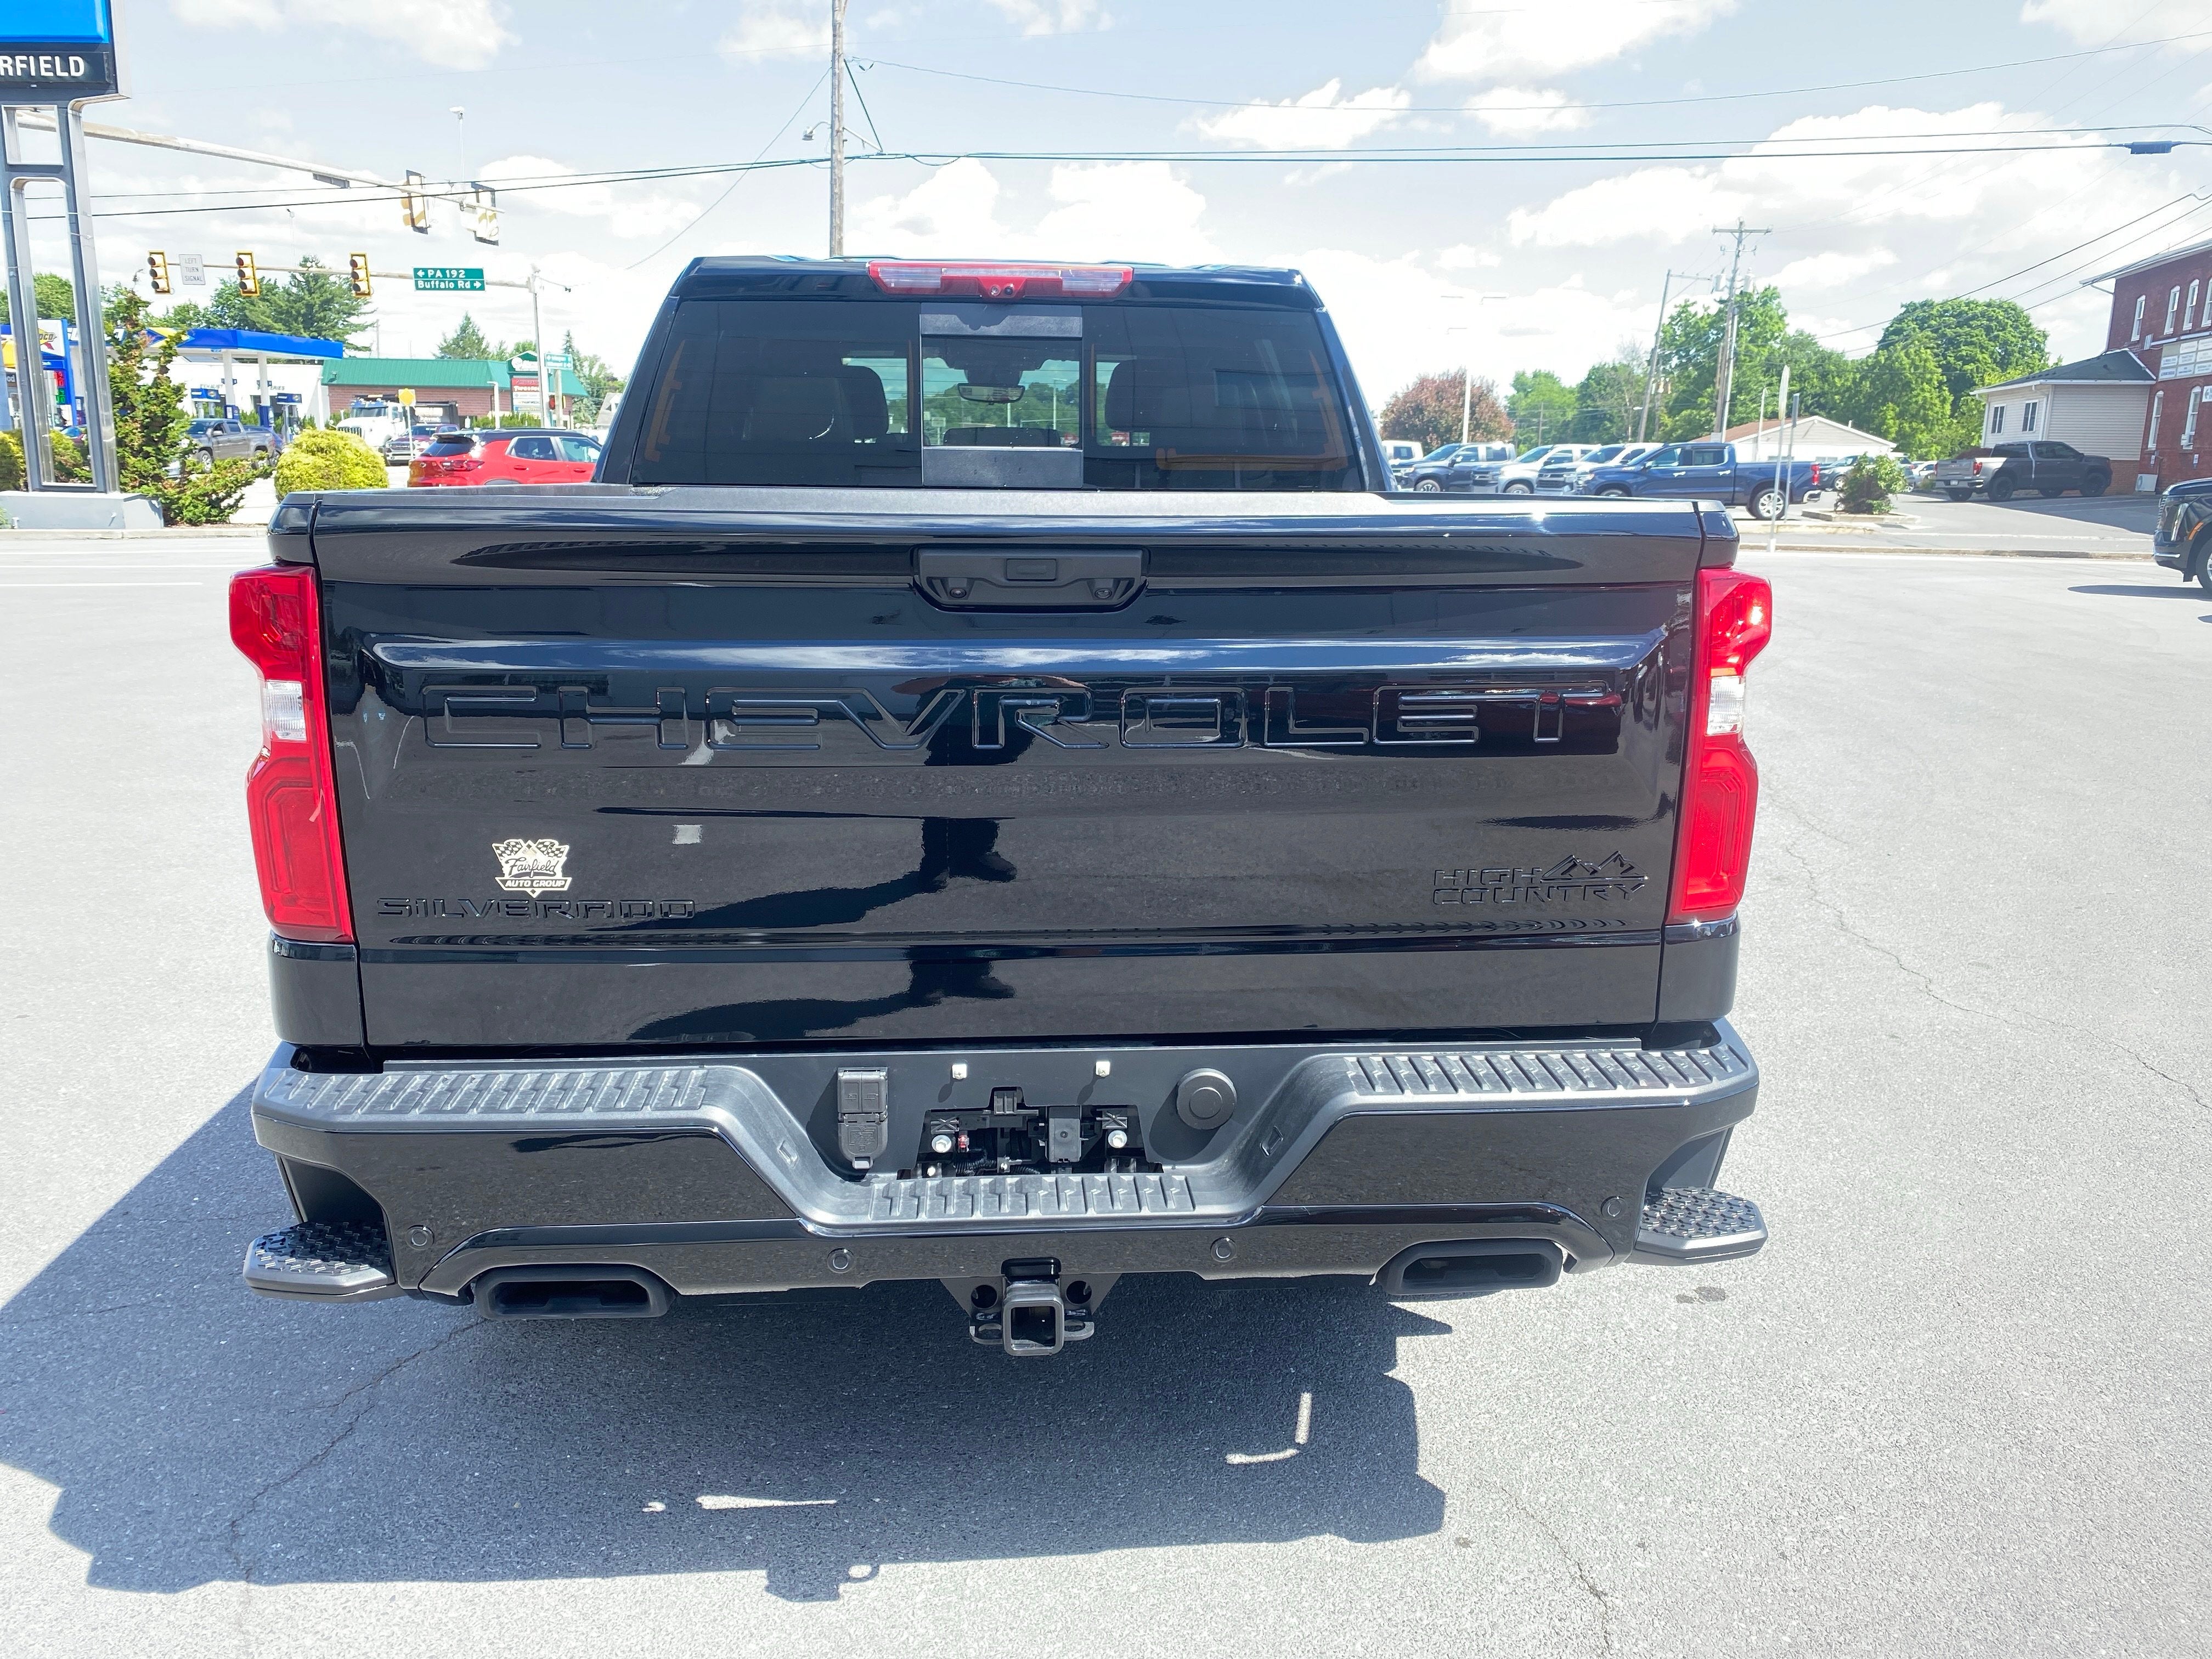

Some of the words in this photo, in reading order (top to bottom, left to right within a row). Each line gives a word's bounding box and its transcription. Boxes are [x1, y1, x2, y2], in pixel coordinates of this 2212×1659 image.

[0, 55, 84, 76] RFIELD
[428, 269, 443, 278] PA
[445, 269, 466, 278] 192
[417, 280, 455, 289] Buffalo
[458, 280, 471, 289] Rd
[422, 680, 1609, 751] CHEVROLET
[505, 857, 560, 877] Fairfield
[1434, 868, 1543, 886] HIGH
[1433, 883, 1646, 905] COUNTRY
[376, 898, 696, 919] SILVERADO
